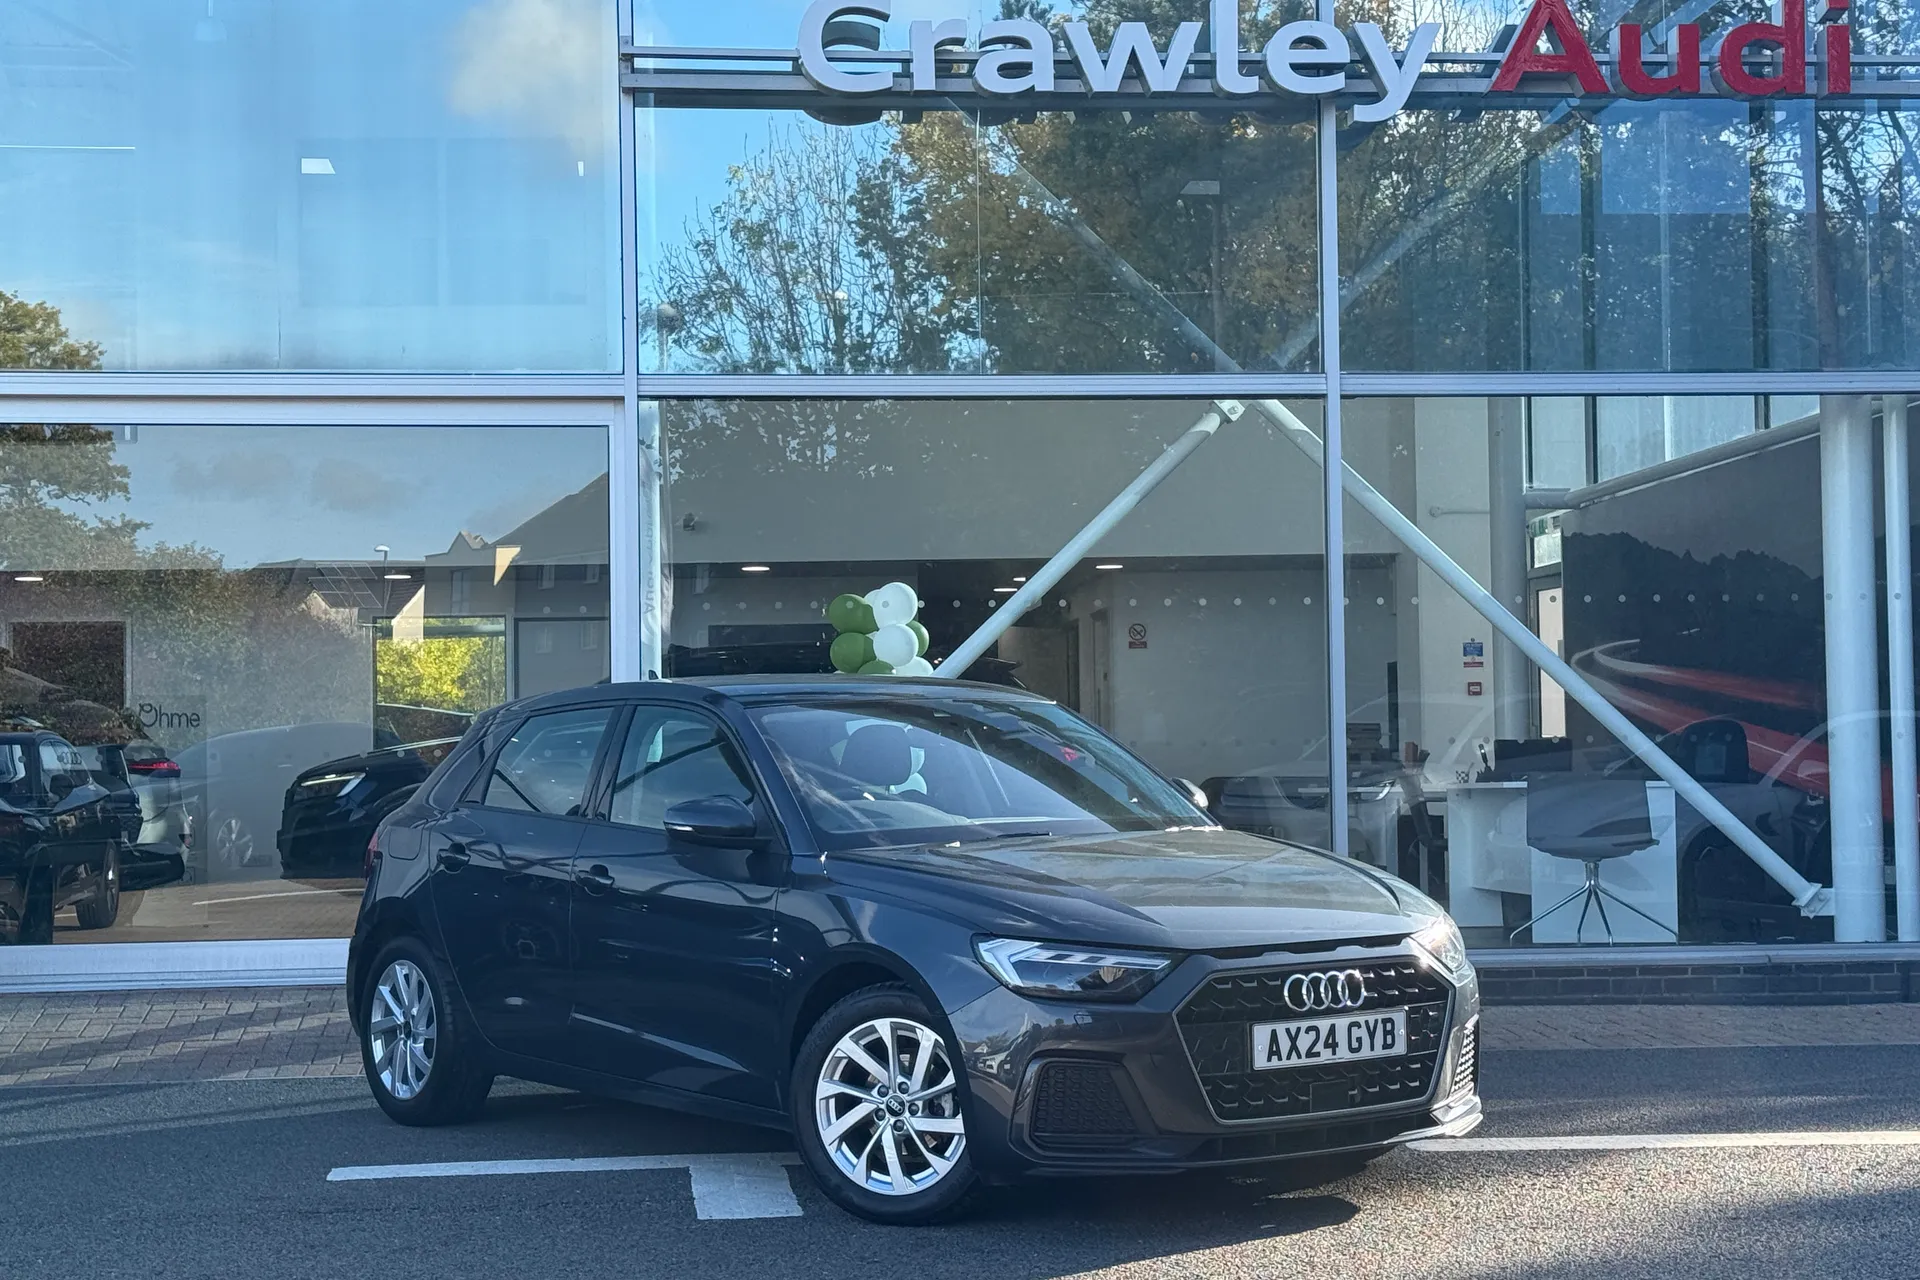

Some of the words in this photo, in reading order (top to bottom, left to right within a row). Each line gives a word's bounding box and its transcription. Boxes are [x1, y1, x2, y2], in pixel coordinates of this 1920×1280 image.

[799, 0, 1441, 122] Crawley
[1490, 0, 1851, 96] Audi
[1266, 1023, 1339, 1062] AX24
[1347, 1017, 1396, 1054] GYB
